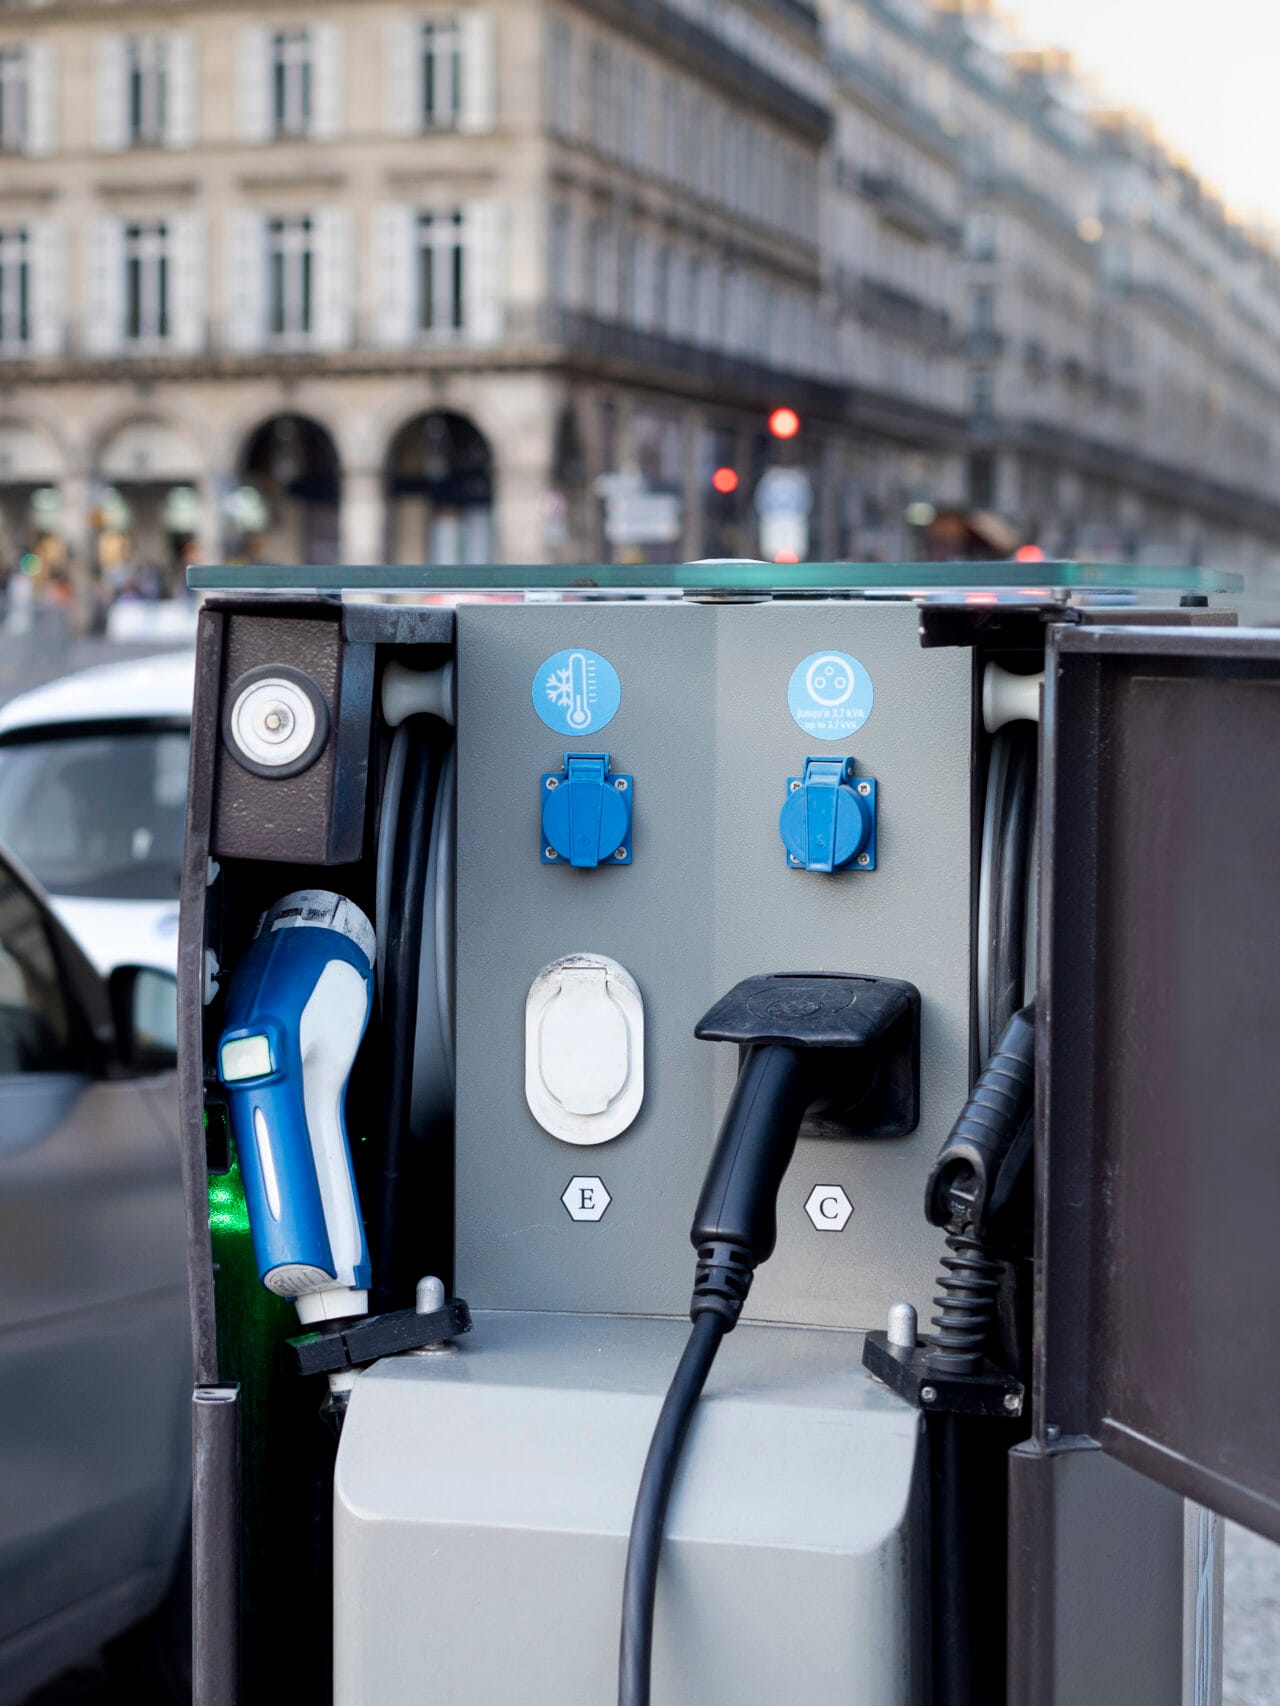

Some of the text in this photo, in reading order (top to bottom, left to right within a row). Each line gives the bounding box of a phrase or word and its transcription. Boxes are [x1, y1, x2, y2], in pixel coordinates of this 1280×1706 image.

[846, 708, 864, 718] kVA
[817, 720, 826, 729] to
[578, 1188, 596, 1210] E
[819, 1197, 839, 1219] C
